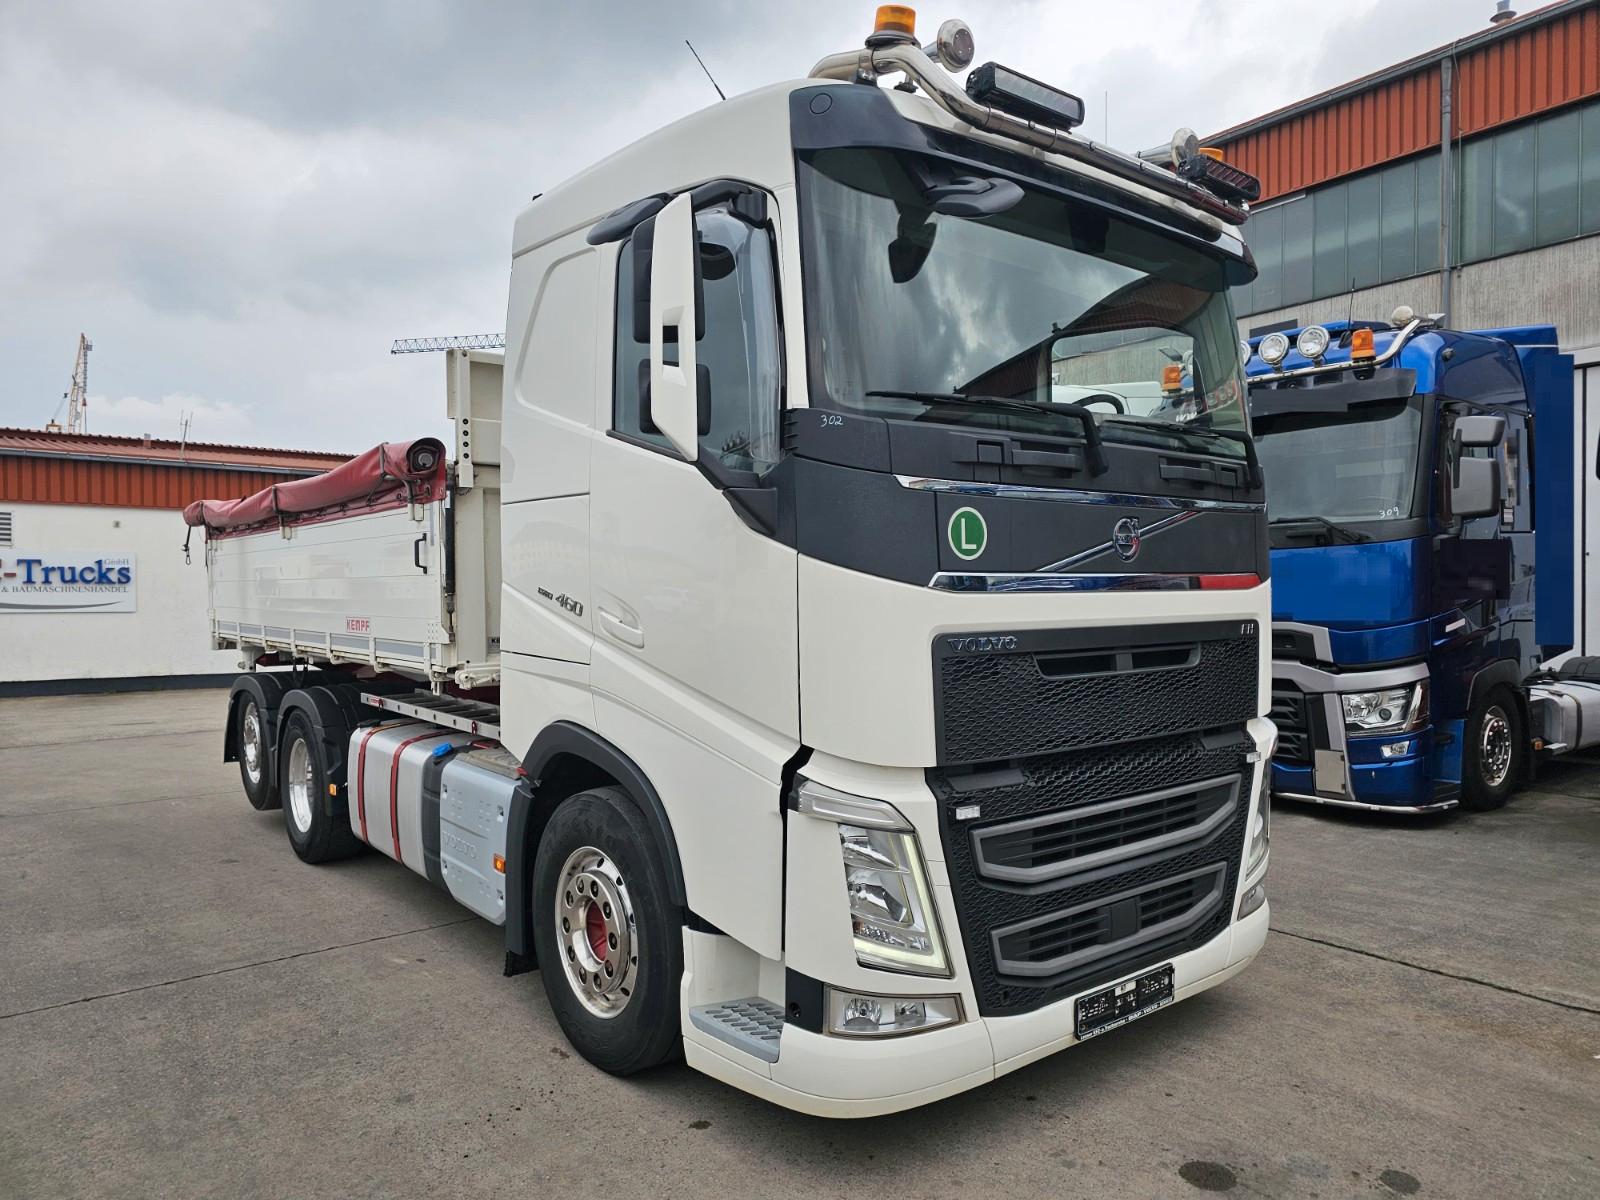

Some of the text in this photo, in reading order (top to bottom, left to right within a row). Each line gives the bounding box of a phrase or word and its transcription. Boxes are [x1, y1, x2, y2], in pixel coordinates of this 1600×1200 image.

[820, 414, 844, 428] 302
[1379, 506, 1399, 519] 309
[961, 517, 977, 550] L
[0, 558, 131, 585] -Trucks
[12, 585, 129, 593] BAUMASCHINENHANDEL
[555, 593, 584, 617] 460
[346, 619, 370, 632] KEMPF
[947, 635, 1017, 652] VOLVO
